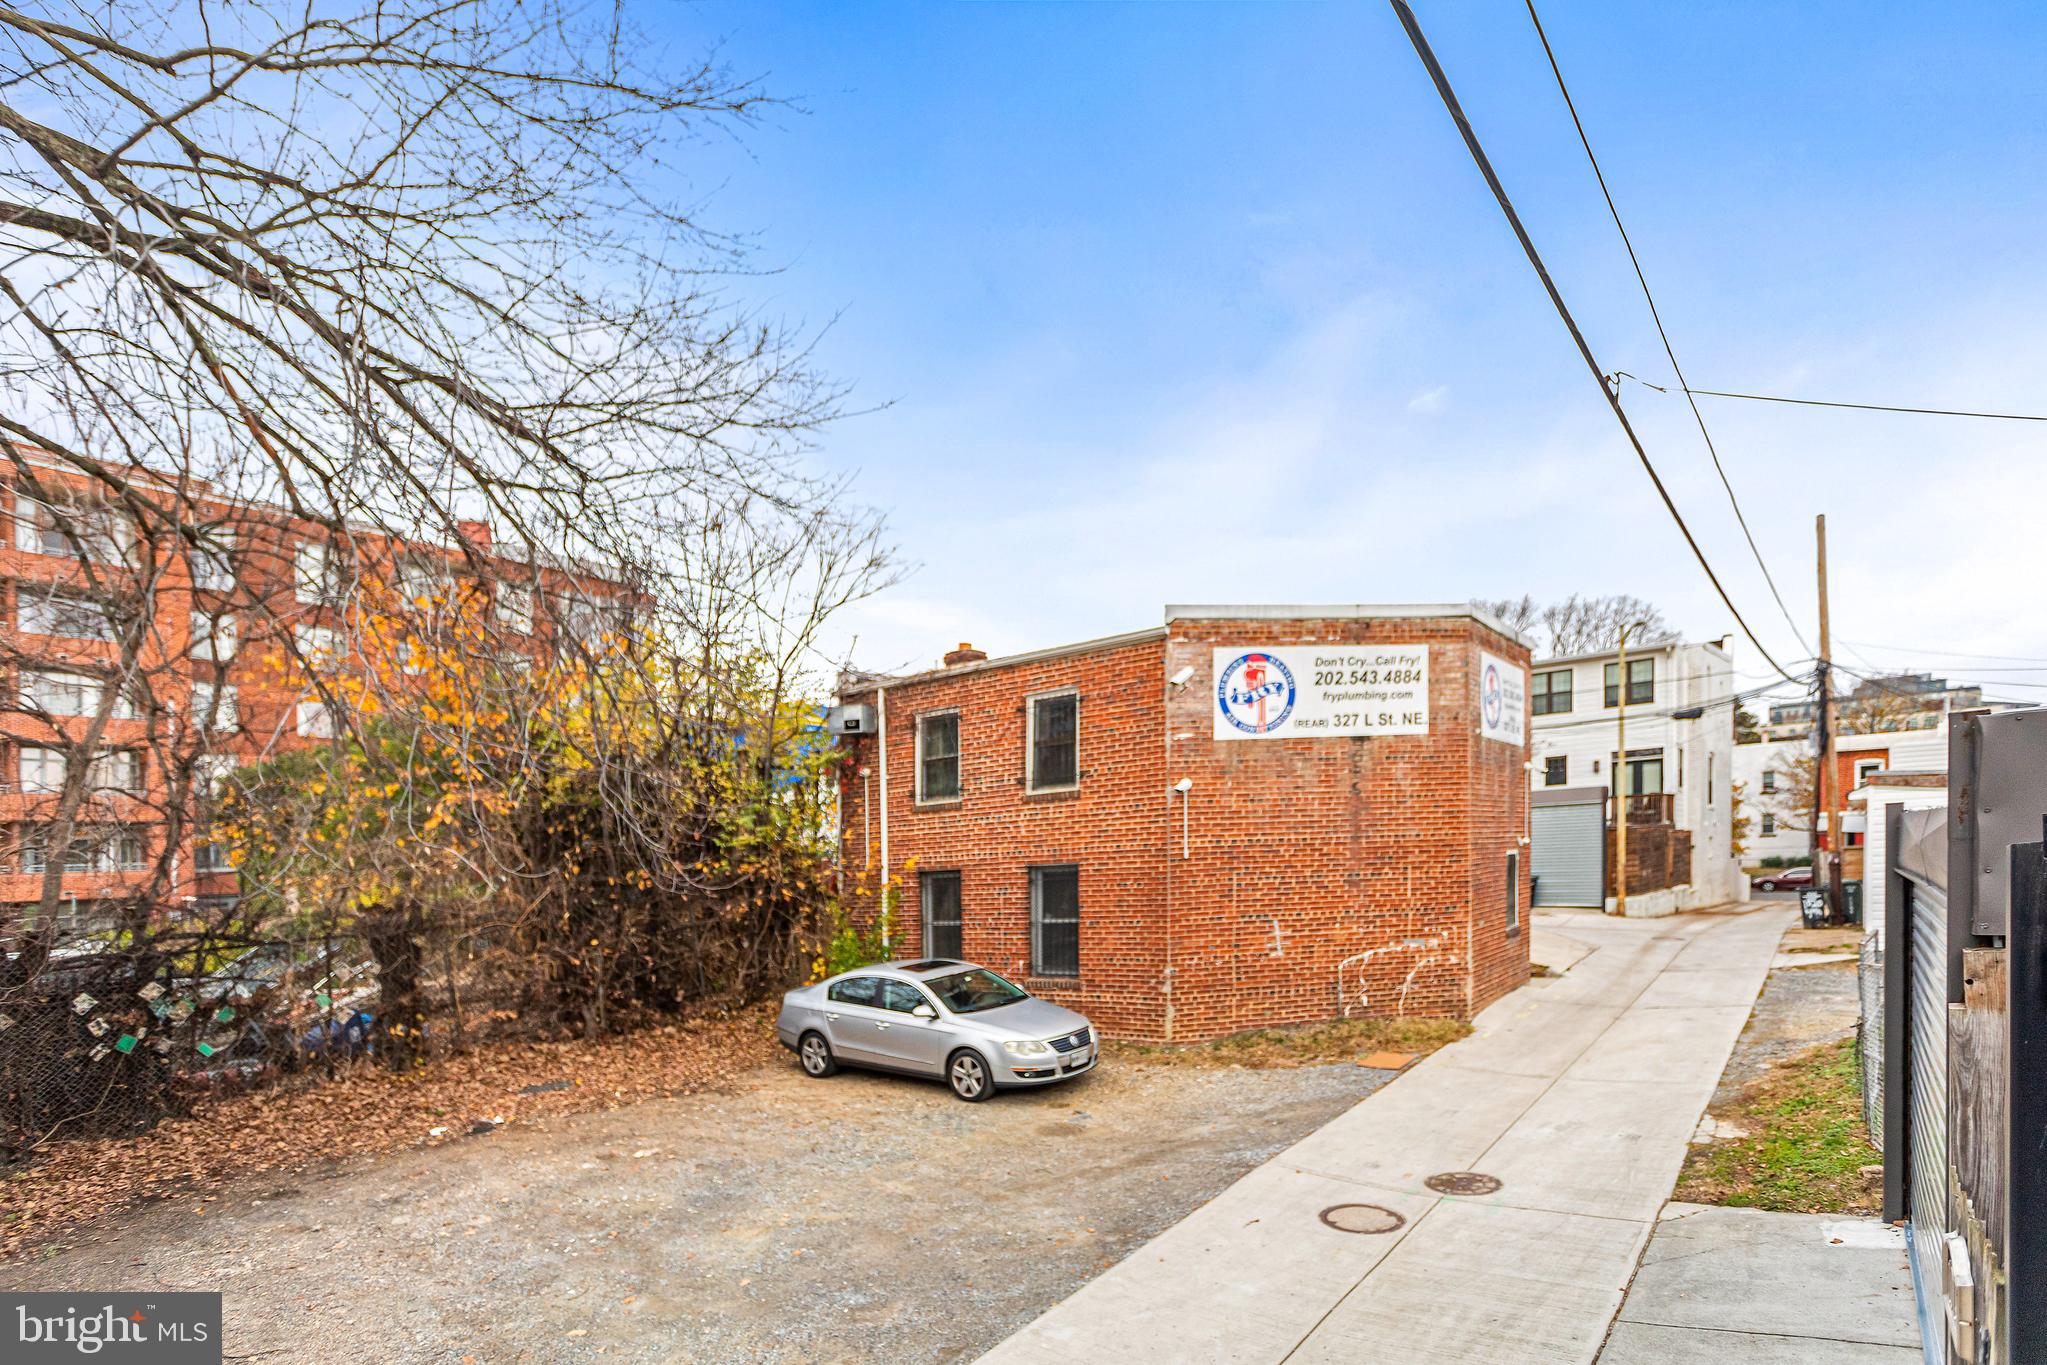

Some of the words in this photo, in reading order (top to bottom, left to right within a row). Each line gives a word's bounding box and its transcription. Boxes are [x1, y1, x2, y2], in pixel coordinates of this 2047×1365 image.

[1315, 657, 1344, 667] Don't
[1400, 655, 1421, 667] Fry!
[1314, 670, 1422, 686] 202.543.4884
[1322, 690, 1414, 703] fryplumbing.com
[1294, 719, 1329, 729] (REAR)
[1333, 714, 1359, 728] 327
[1364, 713, 1374, 727] L
